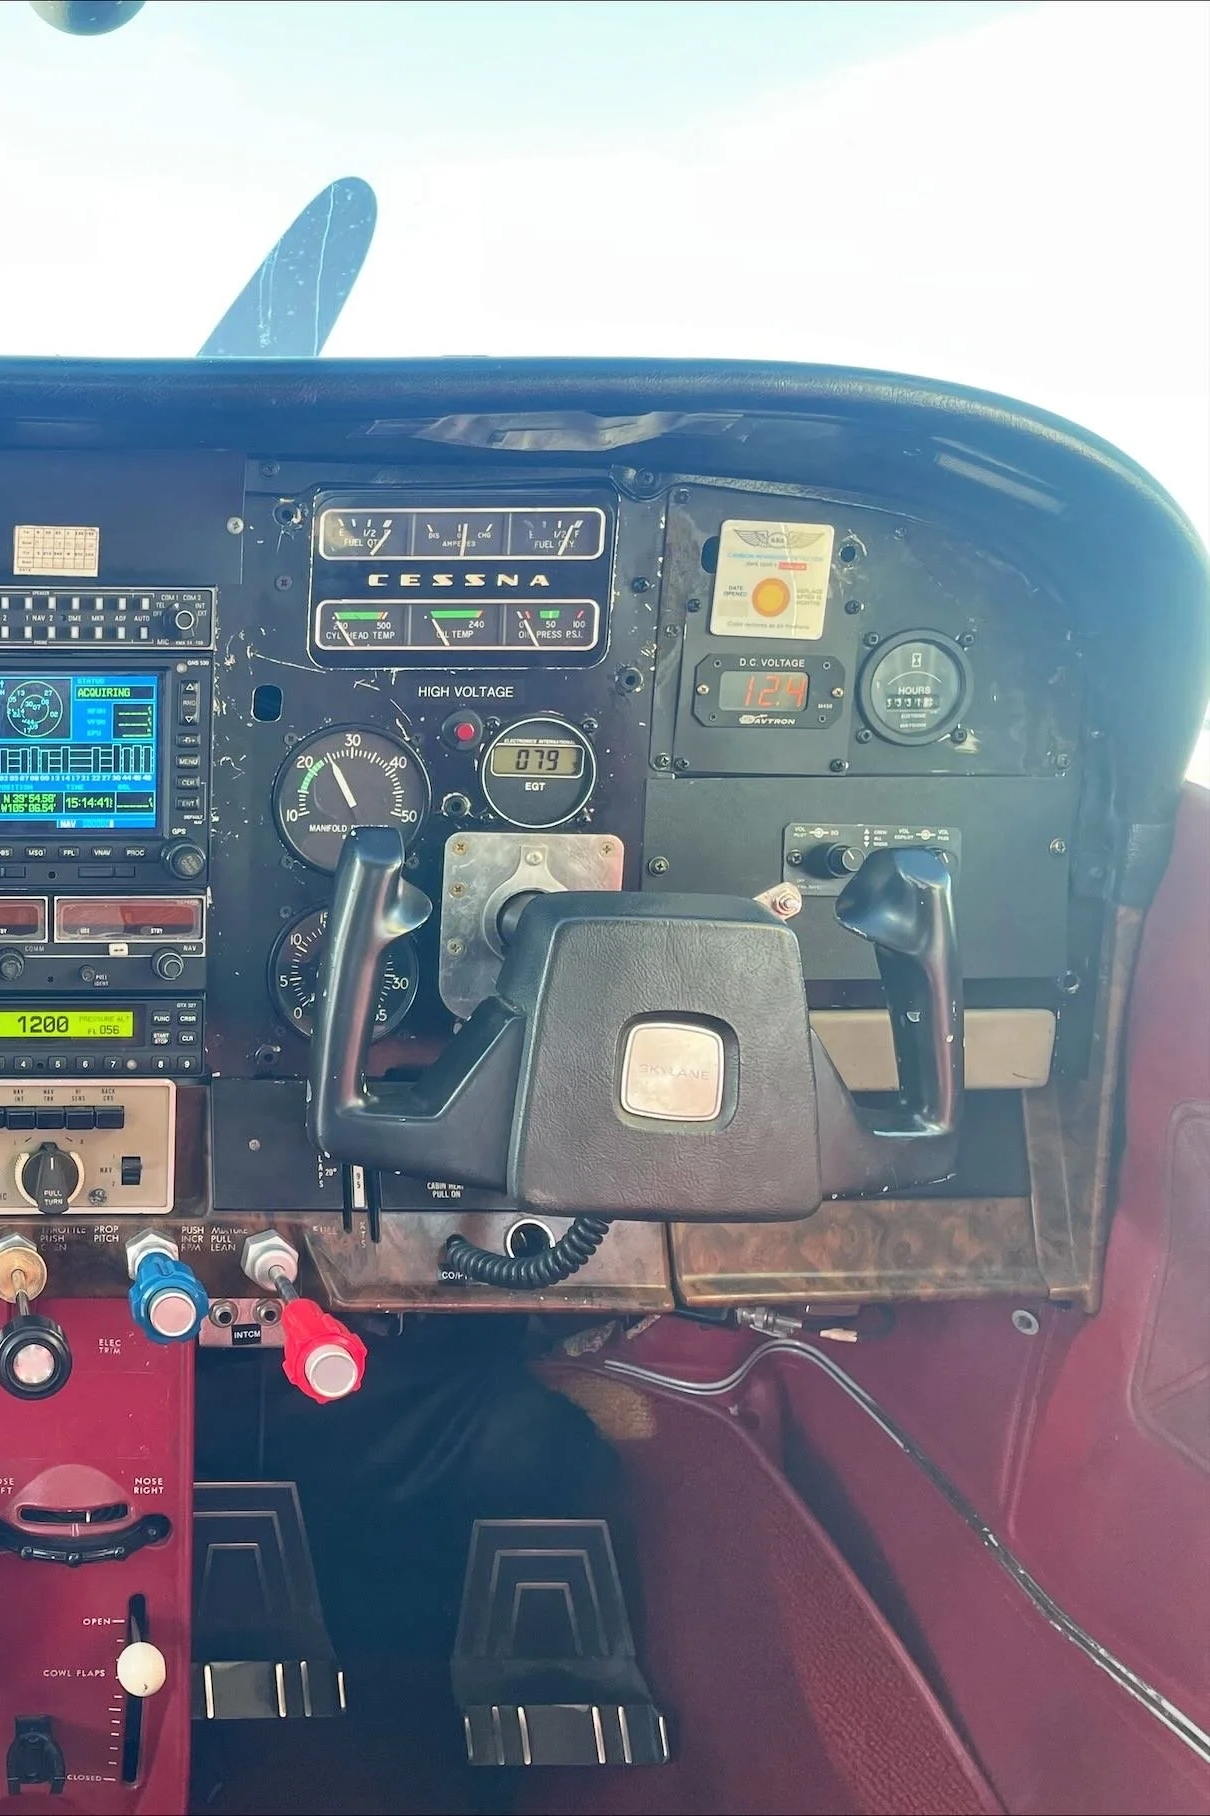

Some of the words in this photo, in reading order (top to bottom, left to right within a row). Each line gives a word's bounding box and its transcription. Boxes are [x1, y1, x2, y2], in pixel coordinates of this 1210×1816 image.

[343, 539, 363, 547] FUEL
[534, 540, 555, 549] FUEL
[367, 573, 550, 587] CESSNA
[376, 621, 391, 630] 500
[468, 620, 485, 629] 240
[373, 631, 395, 640] TEMP
[452, 630, 474, 639] TEMP
[536, 630, 562, 638] PRESS
[761, 659, 805, 668] VOLTAGE
[77, 688, 131, 697] ACQUIRING
[418, 686, 450, 698] HIGH
[454, 686, 513, 698] VOLTAGE
[898, 686, 931, 695] HOURS
[344, 734, 361, 746] 30
[296, 756, 313, 768] 20
[389, 757, 407, 768] 40
[515, 749, 559, 770] 079
[525, 782, 546, 791] EGT
[65, 797, 110, 809] 15:14:41
[286, 810, 298, 822] 10
[401, 810, 417, 823] 50
[290, 933, 302, 946] 10
[391, 978, 409, 989] 30
[17, 1016, 69, 1033] 1200
[99, 1025, 120, 1035] 056
[640, 1064, 710, 1080] SKYLANE
[427, 1182, 446, 1190] CABIN
[94, 1225, 119, 1234] PROP
[181, 1226, 204, 1235] PUSH
[93, 1234, 119, 1243] PITCH
[181, 1235, 204, 1243] INCR
[210, 1235, 231, 1243] PULL
[210, 1243, 236, 1251] LEAN
[233, 1330, 261, 1339] INTCM
[98, 1339, 121, 1347] ELEC
[135, 1478, 163, 1486] NOSE
[133, 1486, 164, 1495] RIGHT
[82, 1618, 110, 1626] OPEN
[77, 1669, 106, 1677] FLAPS
[67, 1774, 102, 1782] CLOSED
